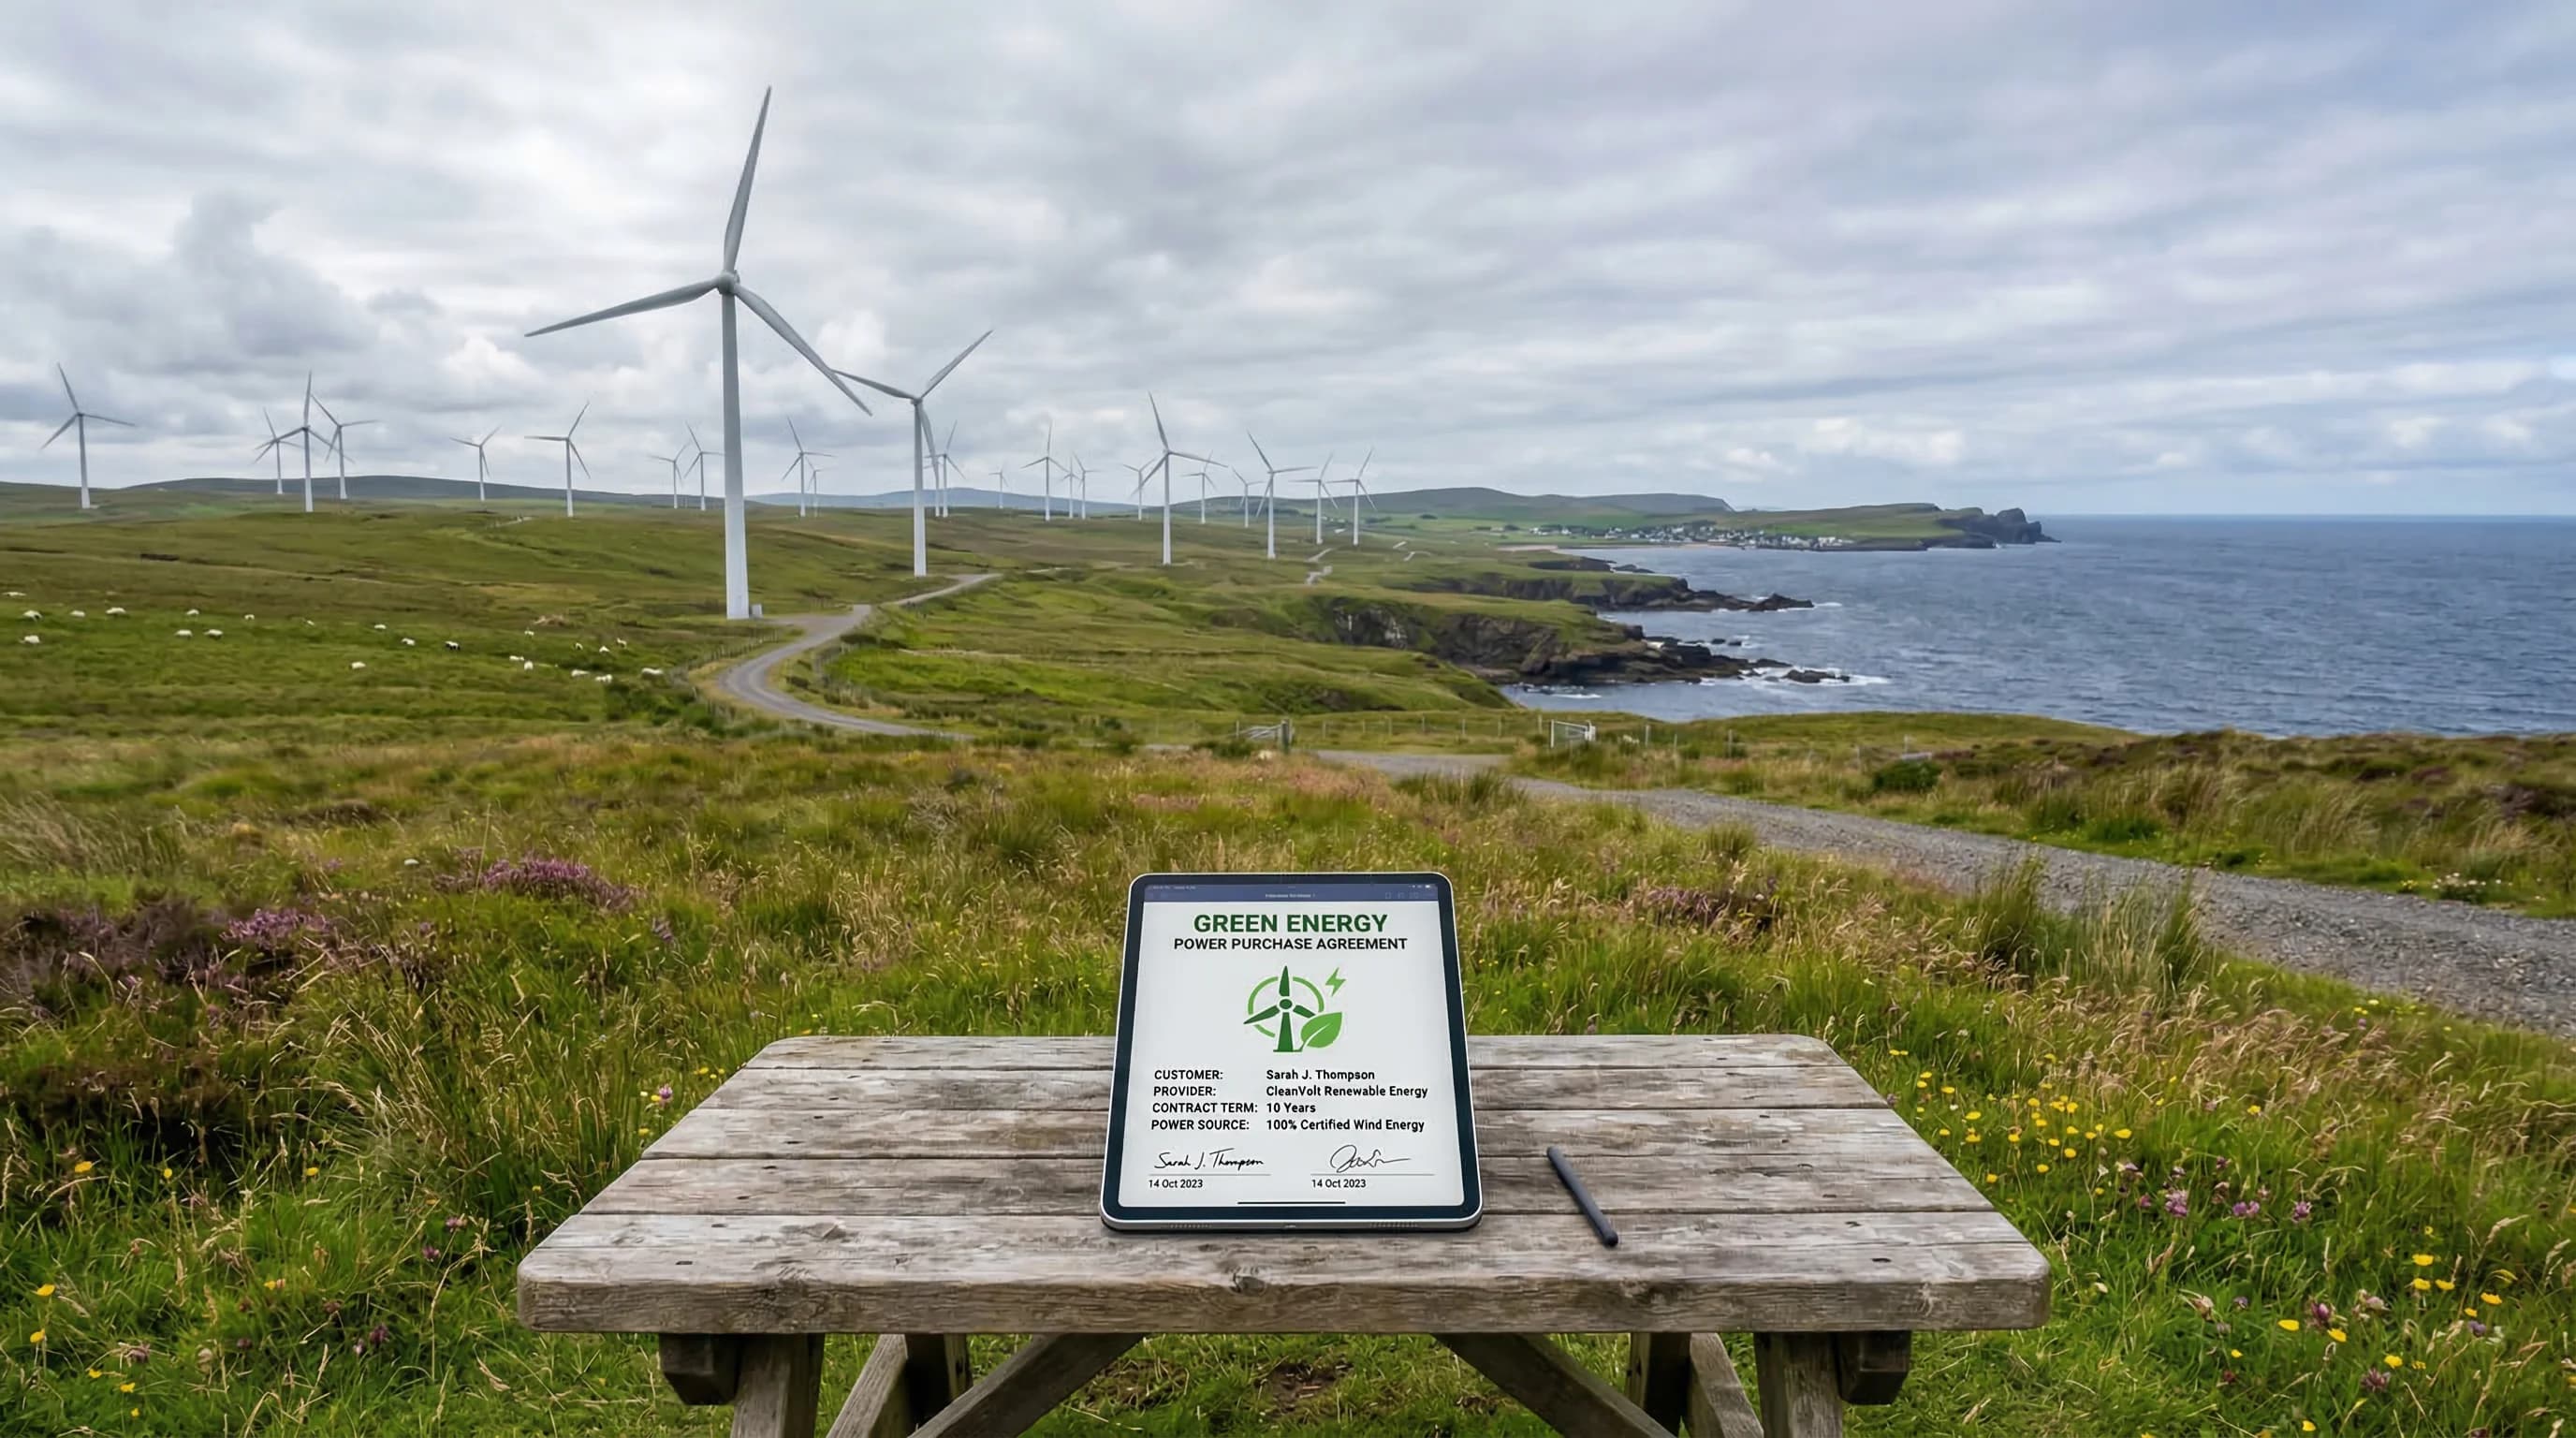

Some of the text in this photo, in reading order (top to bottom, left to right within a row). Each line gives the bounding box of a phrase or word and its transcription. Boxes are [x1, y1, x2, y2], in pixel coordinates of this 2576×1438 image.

[1193, 914, 1388, 933] GREEN ENERGY
[1174, 937, 1409, 950] POWER PURCHASE AGREEMENT
[1154, 1068, 1375, 1083] CUSTOMER: Sarah J. Thompson
[1153, 1084, 1428, 1099] PROVIDER: CleanVolt Renewable Energy
[1152, 1102, 1317, 1114] CONTRACT TERM: 10 Years
[1150, 1118, 1426, 1134] POWER SOURCE: 100% Certified Wind Energy
[1149, 1179, 1204, 1189] 14 Oct 2023
[1311, 1178, 1367, 1189] 14 Oct 2023
